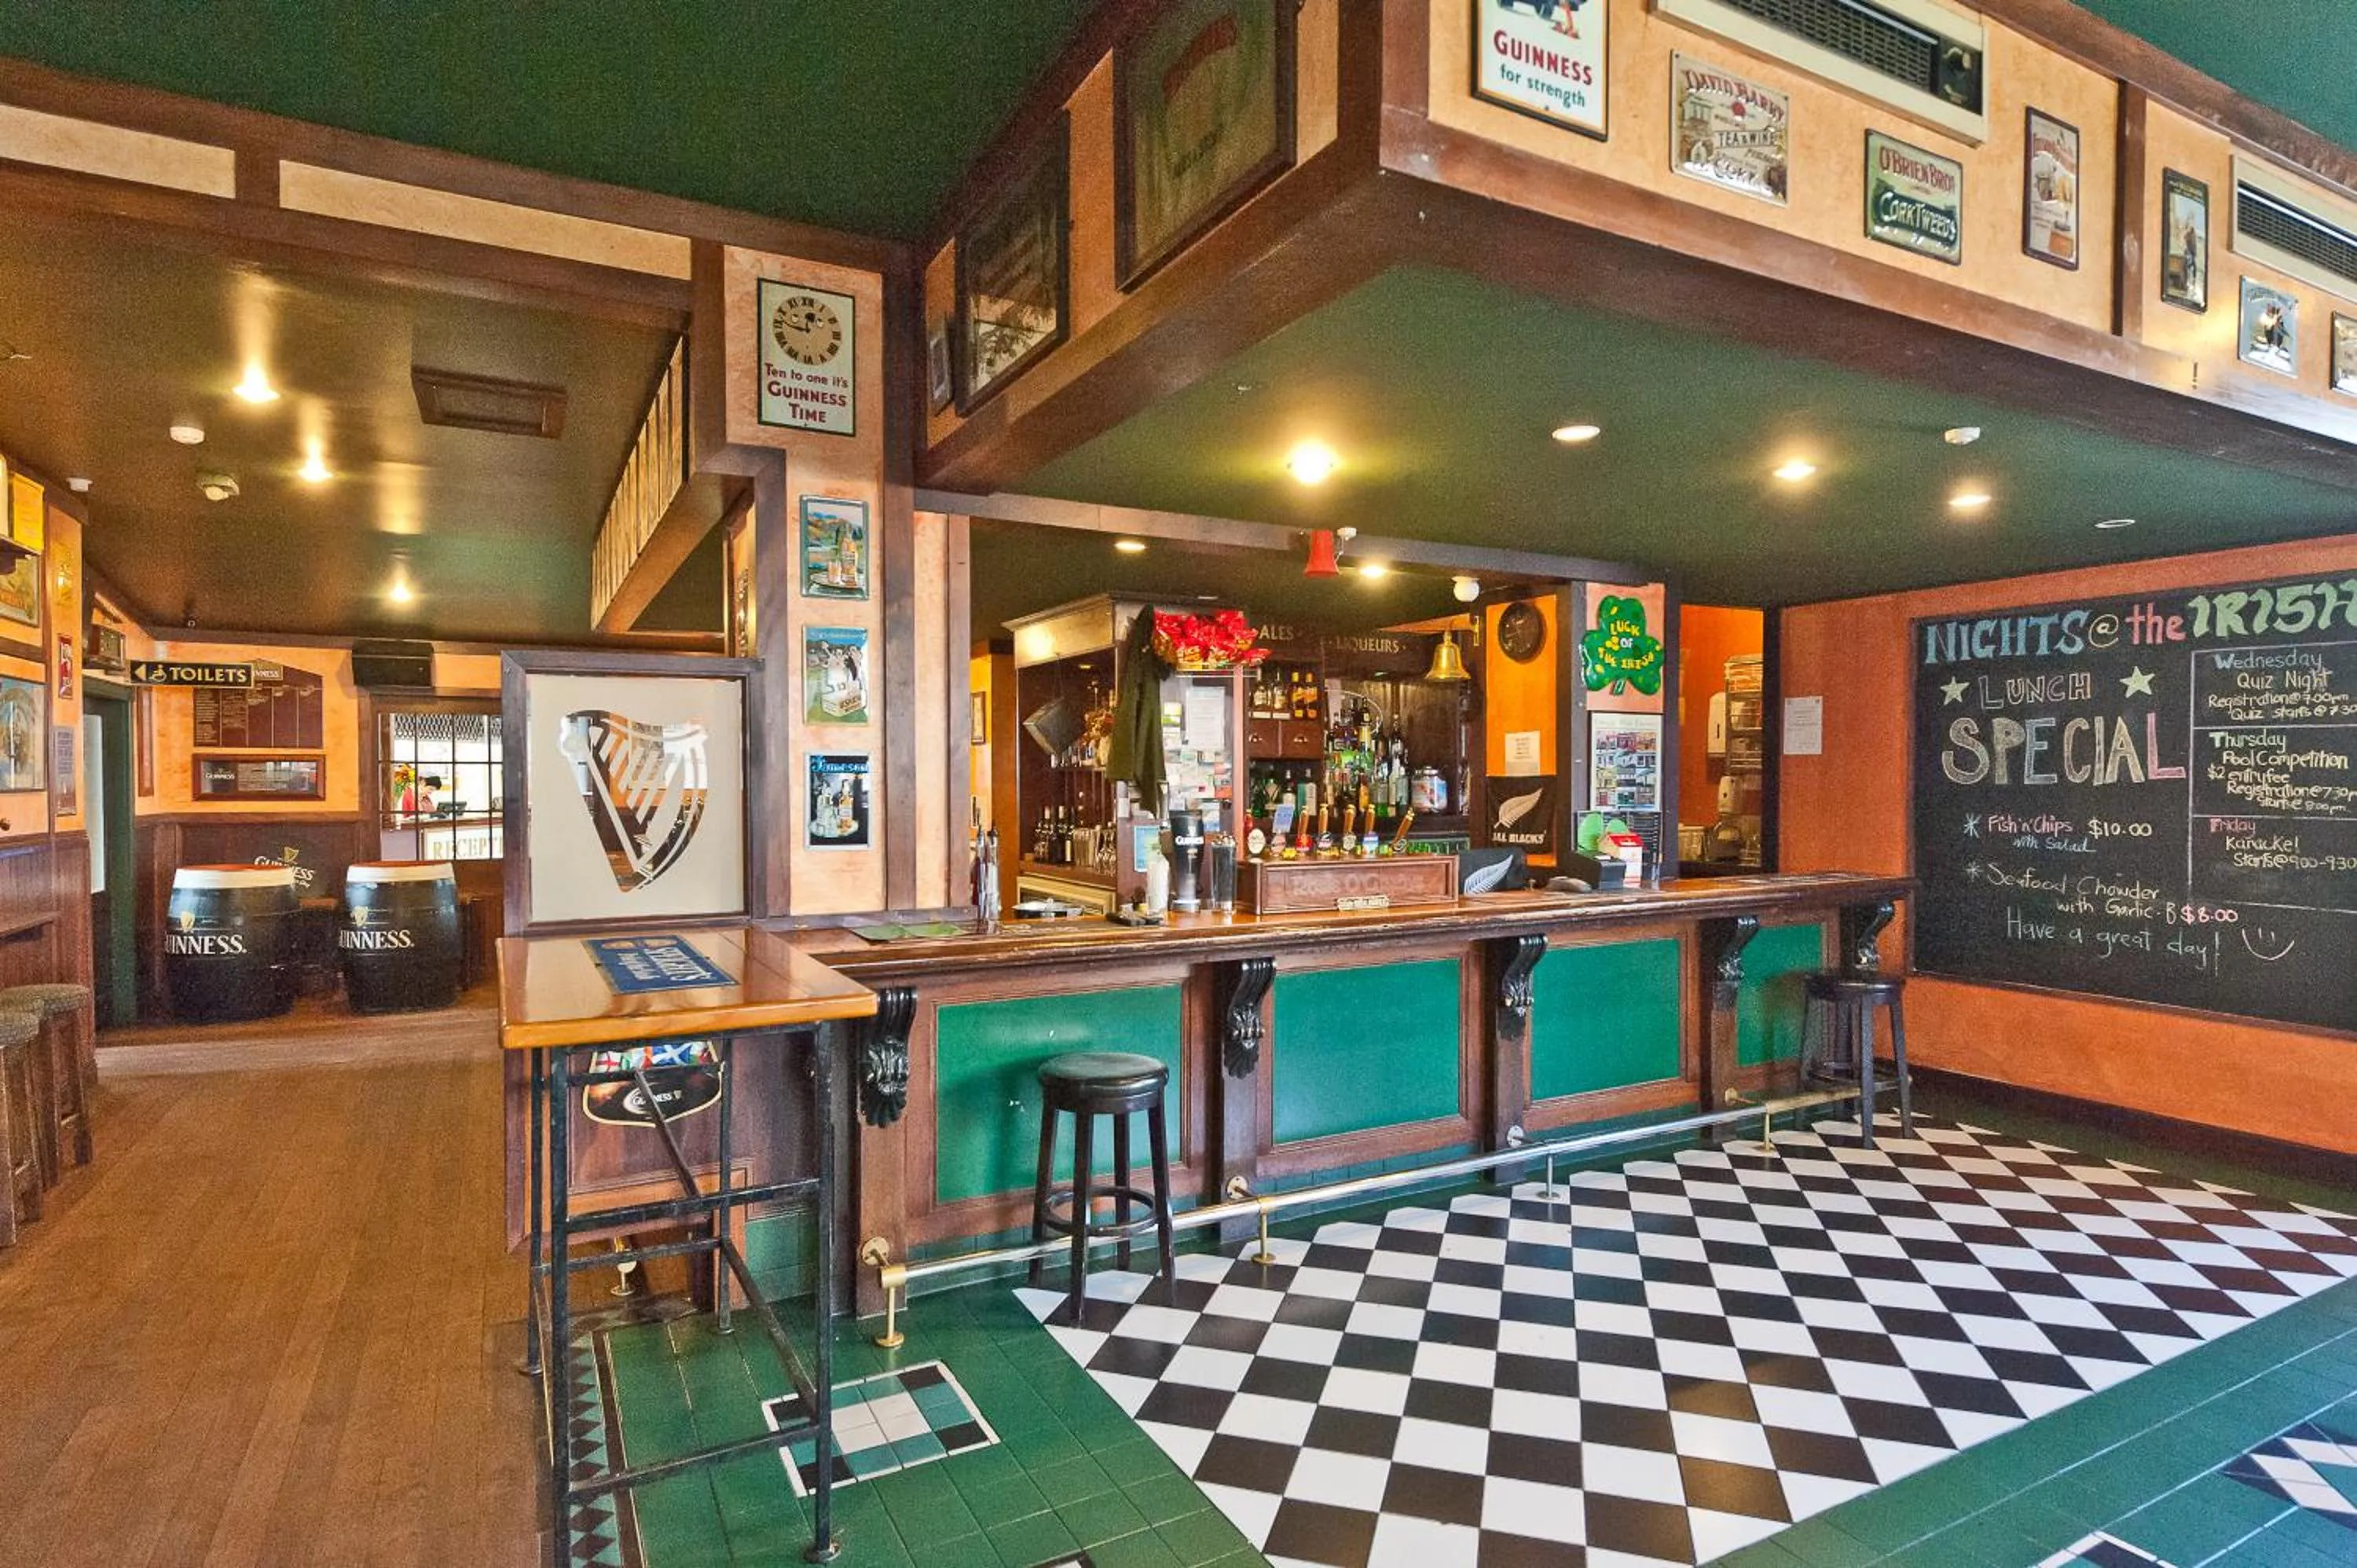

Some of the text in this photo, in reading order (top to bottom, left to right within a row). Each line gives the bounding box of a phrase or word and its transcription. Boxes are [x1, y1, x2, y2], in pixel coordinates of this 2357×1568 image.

[1494, 30, 1593, 86] GUINNESS
[1501, 64, 1585, 108] for strength
[1879, 146, 1930, 184] O'BRIEN
[1879, 191, 1915, 226] CORK
[1915, 203, 1956, 242] TWEEDS
[764, 362, 849, 388] Ten to one it's
[767, 380, 848, 407] GUINNESS
[789, 402, 827, 423] TIME
[1259, 625, 1295, 641] ALES
[1336, 635, 1399, 654] LIQUEURS
[1609, 620, 1640, 636] LUCK
[1925, 610, 2092, 664] NIGHTS
[2124, 603, 2187, 645] the
[1597, 646, 1655, 670] THE IRISH
[2213, 647, 2322, 669] Wednesday
[169, 666, 248, 683] TOILETS
[2237, 668, 2333, 693] Quiz Night
[1977, 672, 2092, 710] LUNCH
[2230, 706, 2264, 722] Quiz
[1941, 711, 2187, 786] SPECIAL
[2209, 728, 2287, 753] Thursday
[2207, 763, 2226, 780] $2
[2223, 749, 2349, 772] Pool Competition
[1508, 832, 1545, 844] BLACKS
[1989, 814, 2018, 833] Fish
[2033, 814, 2073, 837] Chips
[2088, 816, 2153, 839] $10.00
[2209, 819, 2256, 838] Friday
[2013, 833, 2097, 853] with Salad
[1987, 863, 2160, 900] Seafood Chowder
[2057, 897, 2095, 914] with
[2007, 905, 2055, 940] Have
[2069, 927, 2083, 943] a
[2096, 929, 2150, 958] great
